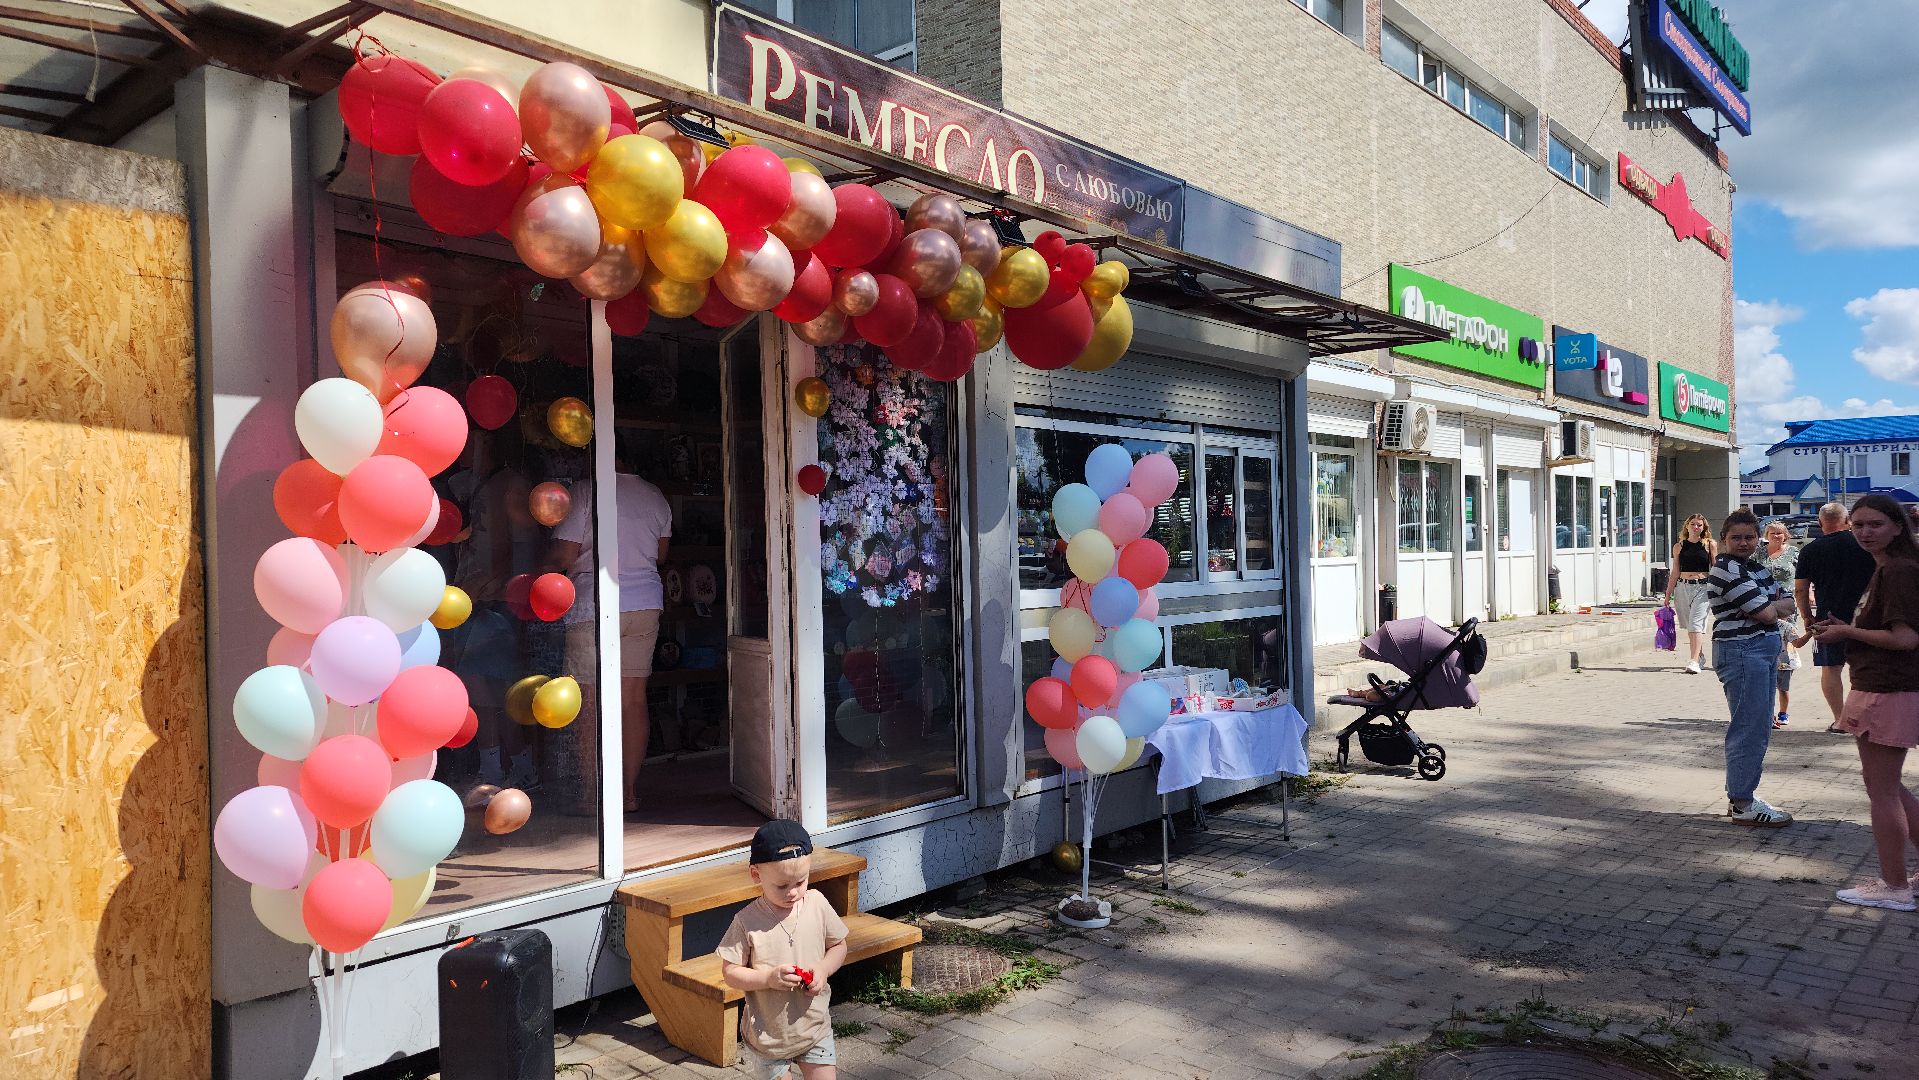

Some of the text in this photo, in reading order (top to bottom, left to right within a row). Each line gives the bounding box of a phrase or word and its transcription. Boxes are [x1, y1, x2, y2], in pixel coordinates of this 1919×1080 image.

[745, 34, 1173, 223] РЕМЕСЛО С ЛЮБОВЬЮ
[1563, 356, 1588, 365] YOTA
